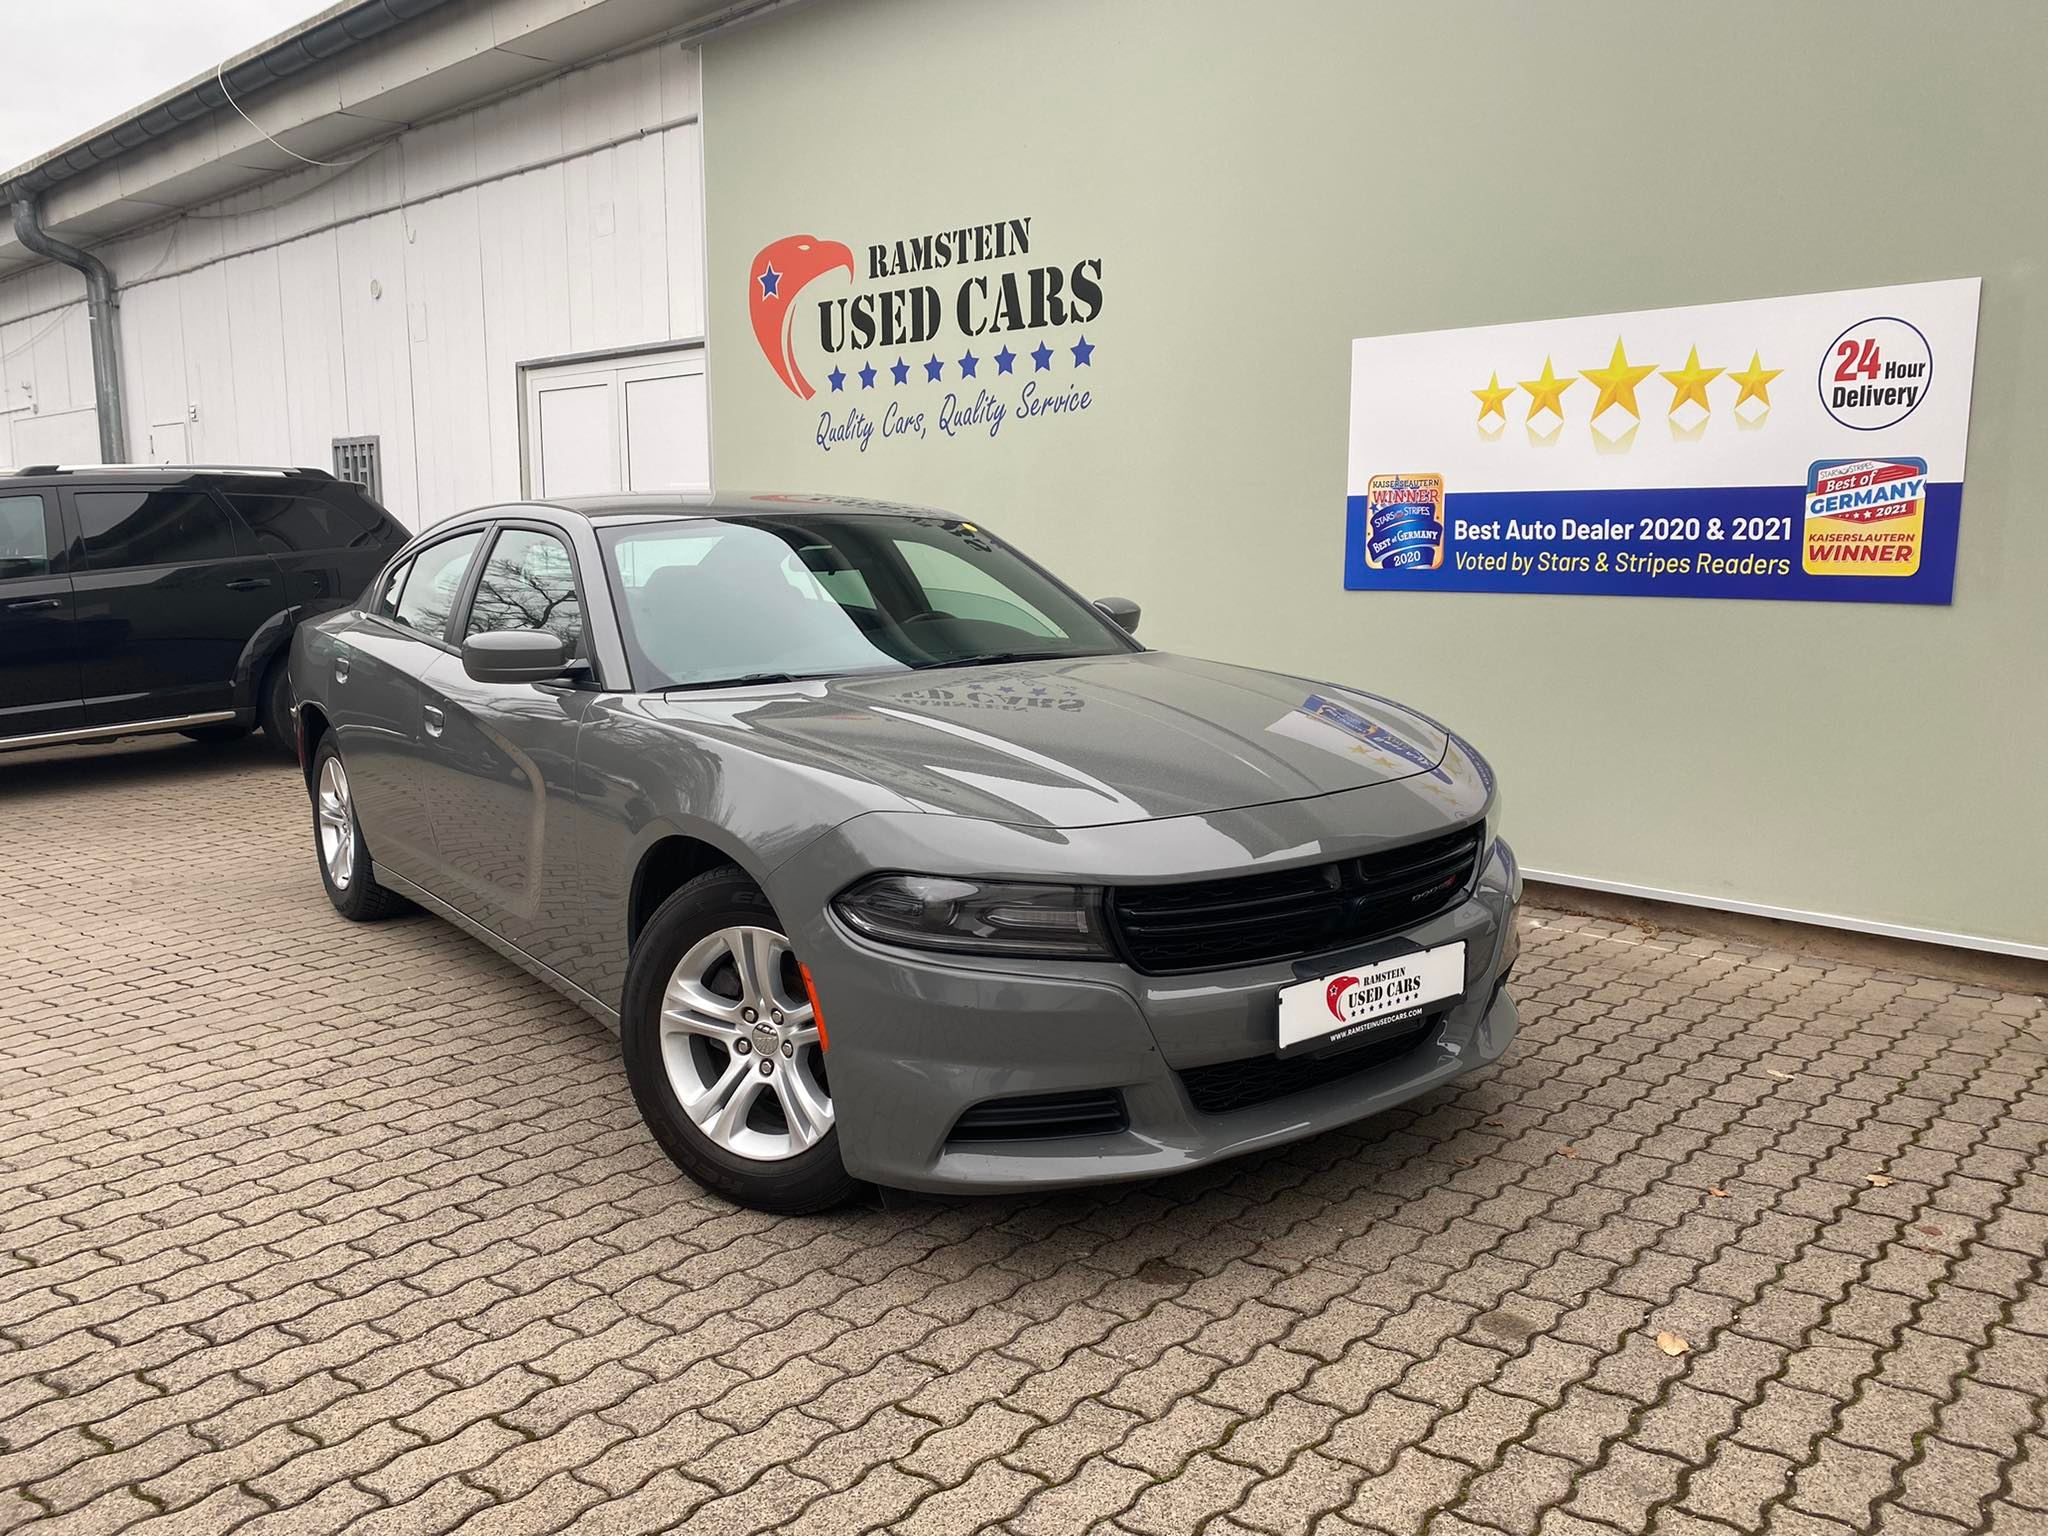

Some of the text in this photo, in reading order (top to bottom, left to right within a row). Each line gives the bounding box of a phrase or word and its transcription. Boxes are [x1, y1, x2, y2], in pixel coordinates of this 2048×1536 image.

[868, 217, 1031, 279] RAMSTEIN
[818, 258, 1103, 353] USED CARS
[1834, 338, 1926, 382] 24 Hour
[1832, 385, 1918, 408] Delivery
[815, 380, 1093, 453] Quality Cars, Quality Service
[1372, 479, 1440, 489] KAISERSLAUTERN
[1825, 470, 1878, 494] Best of
[1372, 489, 1440, 505] WINNER
[1810, 479, 1924, 515] GERMANY
[1374, 506, 1431, 528] STARS STRIPES
[1875, 503, 1907, 517] 2021
[1454, 517, 1792, 541] Best Auto Dealer 2020 & 2021
[1809, 533, 1916, 543] KAISERSLAUTERN
[1372, 537, 1391, 553] BEST
[1397, 530, 1439, 541] GERMANY
[1808, 544, 1914, 562] WINNER
[1393, 550, 1421, 567] 2020
[1455, 551, 1791, 578] Voted by Stars & Stripes Readers
[1363, 966, 1406, 987] RAMSTEIN
[1348, 975, 1421, 1009] USED CARS
[1330, 1007, 1423, 1042] WWW.RAMSTEINUSEDCARS.COM
